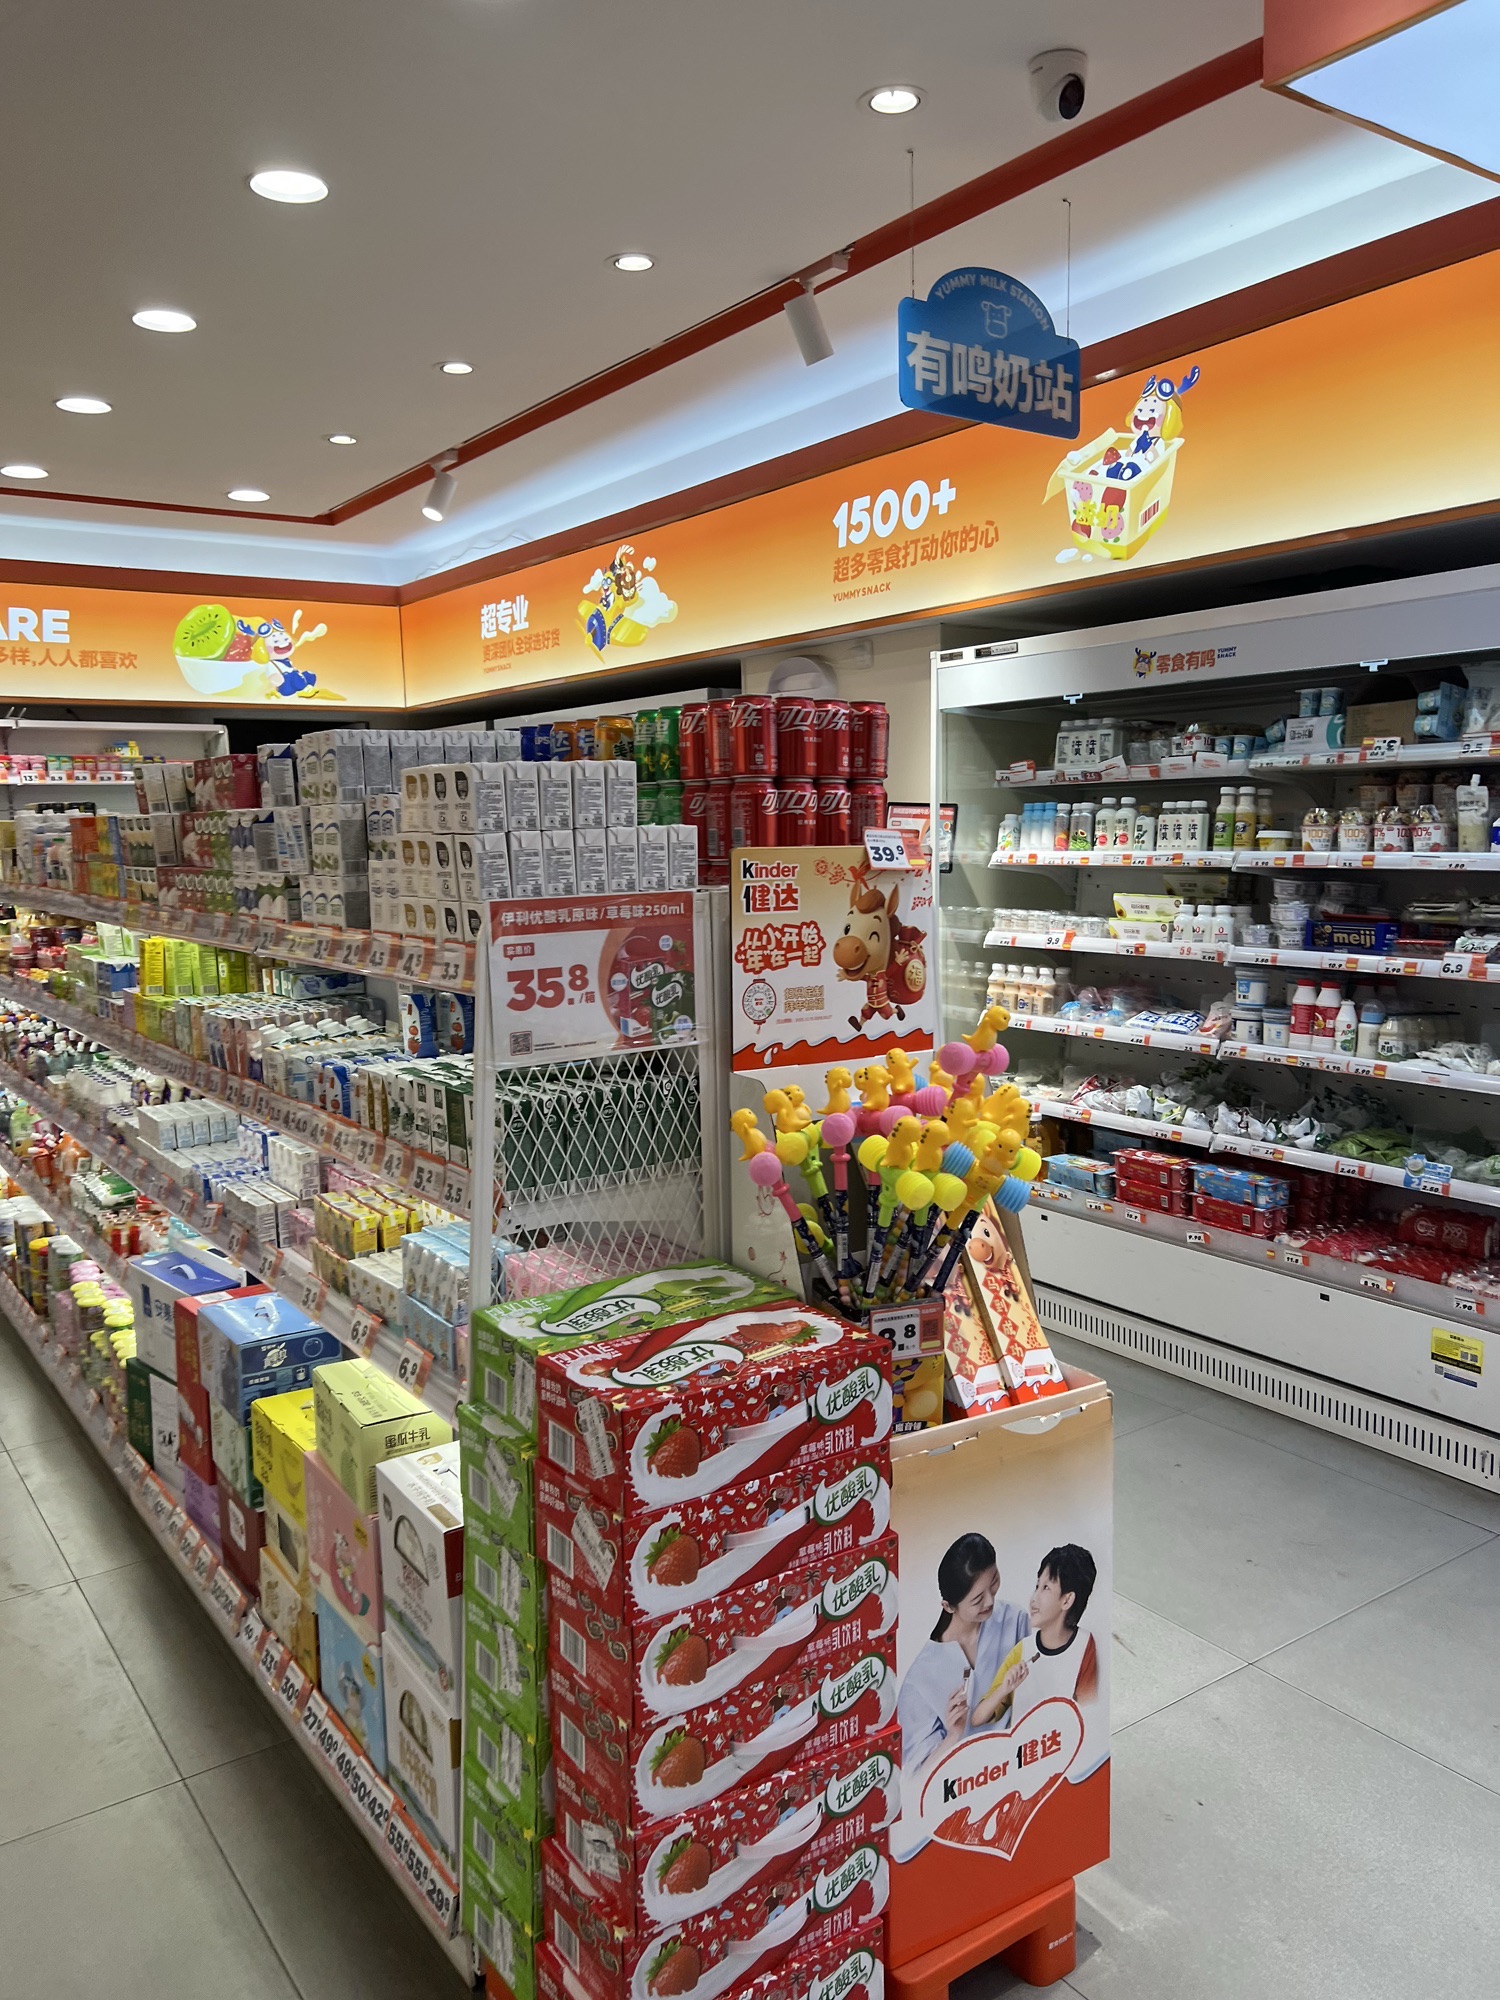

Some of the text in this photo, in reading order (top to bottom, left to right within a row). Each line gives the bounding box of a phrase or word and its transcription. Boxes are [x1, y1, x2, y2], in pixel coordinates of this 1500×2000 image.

[935, 274, 1050, 331] YUMMY MILK STATION
[906, 331, 1074, 422] 有鸣奶站
[832, 478, 956, 548] 1500+
[833, 520, 999, 584] 超多零食打动你的心
[833, 582, 891, 602] YUMMYSNACK
[0, 607, 70, 643] RE
[480, 594, 529, 640] 超专业
[1156, 649, 1216, 674] 零食有鸣
[1308, 829, 1331, 838] 100%
[1344, 829, 1368, 838] 100%
[742, 860, 799, 879] Kinder
[870, 845, 904, 862] 39.9
[742, 883, 799, 913] 健达
[501, 903, 684, 927] 伊利优酸乳原味/草莓味250ml
[744, 924, 820, 951] 从小开始
[1047, 937, 1060, 946] 9.9
[1333, 930, 1376, 948] meiji
[1463, 942, 1490, 953] Dove
[1442, 963, 1463, 973] 6.9
[506, 964, 590, 1012] 35.8
[413, 1165, 433, 1191] 5.2
[556, 1299, 636, 1331] 优酸乳
[1455, 1302, 1472, 1311] 7.90
[629, 1345, 716, 1382] 优酸乳
[826, 1368, 873, 1416] 优酸乳
[385, 1427, 431, 1449] 蜜瓜牛乳
[825, 1425, 855, 1456] 乳饮料
[824, 1468, 872, 1517] 优酸乳
[823, 1524, 853, 1556] 乳饮料
[832, 1563, 880, 1612] 优酸乳
[832, 1618, 862, 1651] 乳饮料
[830, 1659, 878, 1710] 优酸乳
[829, 1714, 859, 1747] 乳饮料
[943, 1729, 1062, 1803] Kinder 健达
[836, 1757, 885, 1810] 优酸乳
[835, 1813, 865, 1847] 乳饮料
[824, 1850, 871, 1905] 优酸乳
[823, 1906, 853, 1940] 乳饮料
[819, 1955, 867, 2000] 优酸乳
